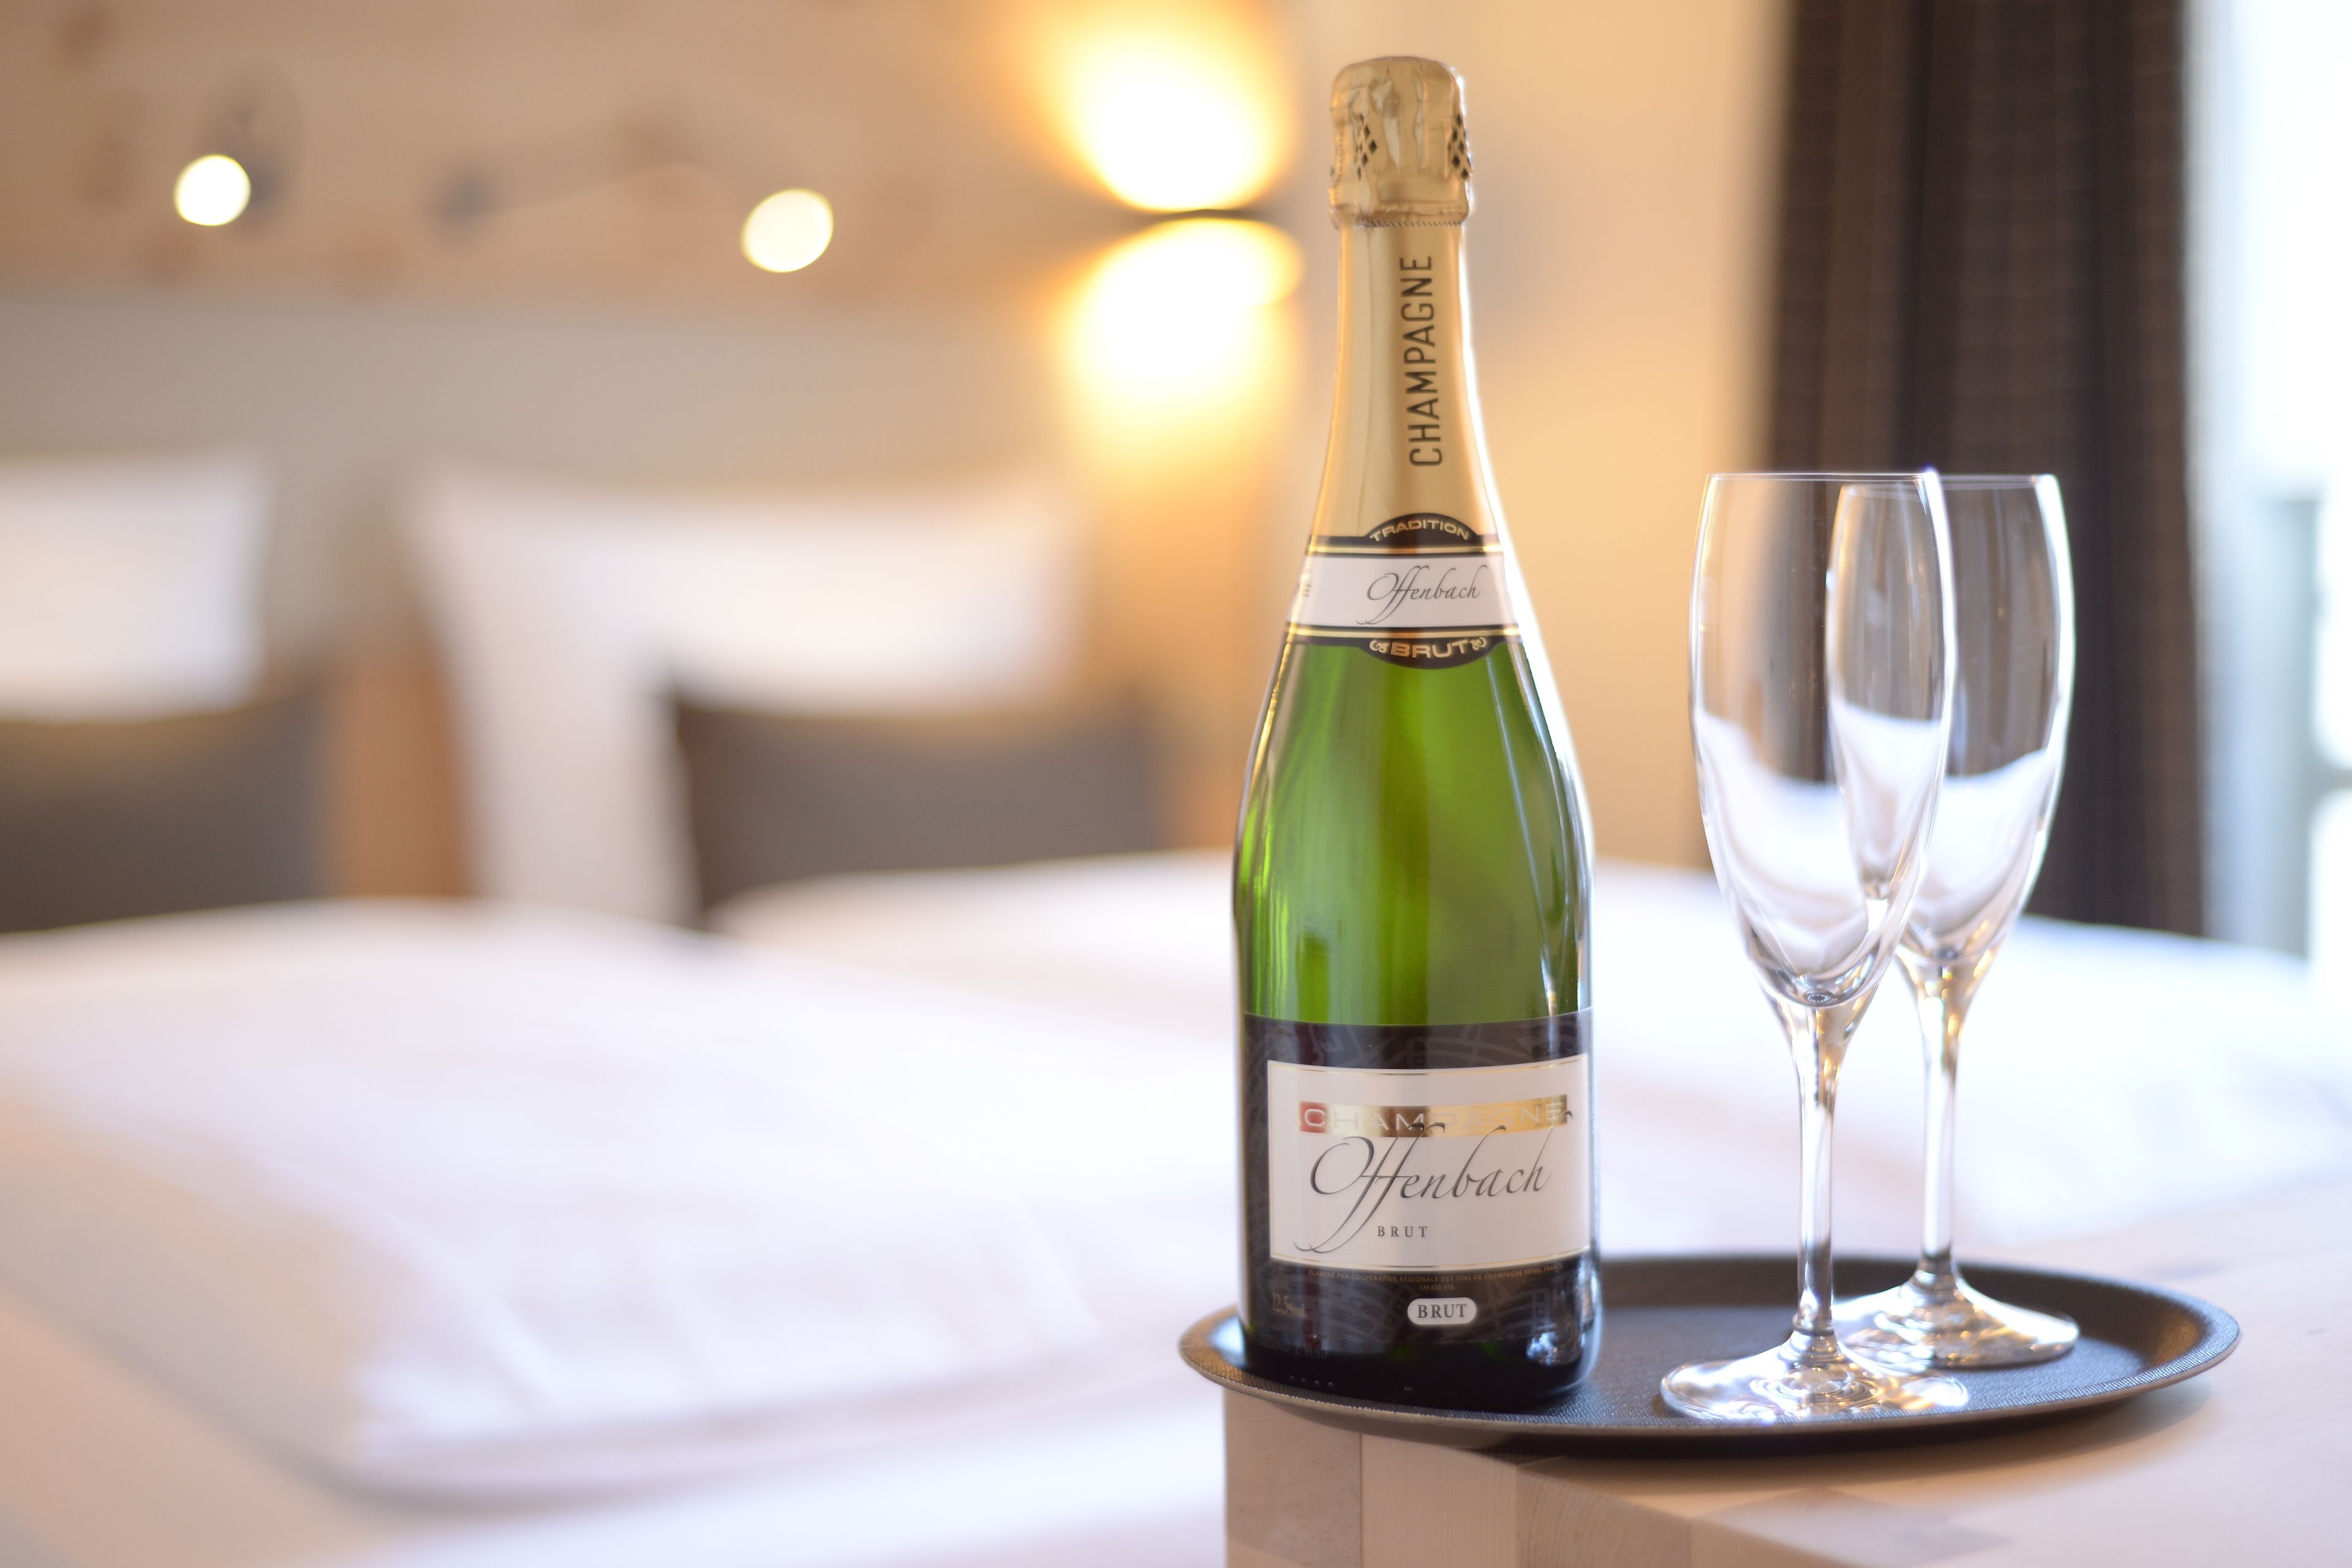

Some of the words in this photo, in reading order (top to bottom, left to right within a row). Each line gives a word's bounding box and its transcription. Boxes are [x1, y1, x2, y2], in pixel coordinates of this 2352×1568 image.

[1399, 255, 1443, 467] CHAMPAGNE
[1369, 519, 1470, 543] TRADITION
[1355, 564, 1488, 625] Offenbach
[1390, 639, 1469, 659] BRUT
[1303, 1101, 1563, 1131] CHAMPAGNE
[1293, 1110, 1573, 1254] Offenbach
[1376, 1226, 1428, 1238] BRUT
[1483, 1269, 1523, 1280] CHAMPAGNE
[1416, 1303, 1468, 1319] BRUT
